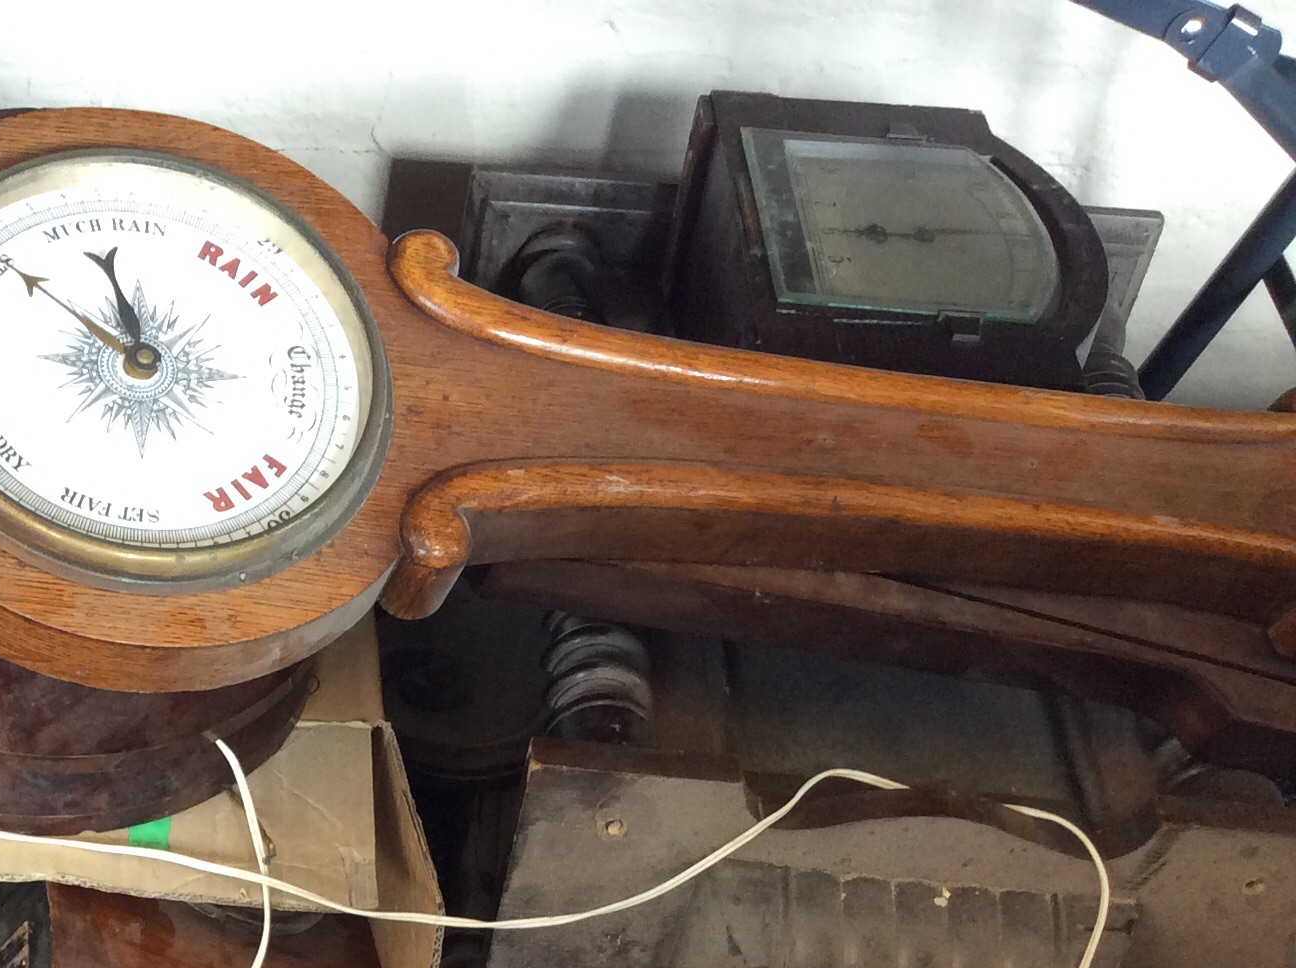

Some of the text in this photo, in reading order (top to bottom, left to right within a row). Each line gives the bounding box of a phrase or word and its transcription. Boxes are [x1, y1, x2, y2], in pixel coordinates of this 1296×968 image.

[42, 217, 167, 244] MUCH RAIN
[197, 240, 279, 307] RAIN
[283, 345, 312, 419] Change
[341, 414, 351, 422] 6
[334, 442, 345, 450] 7
[203, 453, 288, 513] FAIR
[299, 494, 310, 503] 9
[59, 486, 161, 524] SET FAIR
